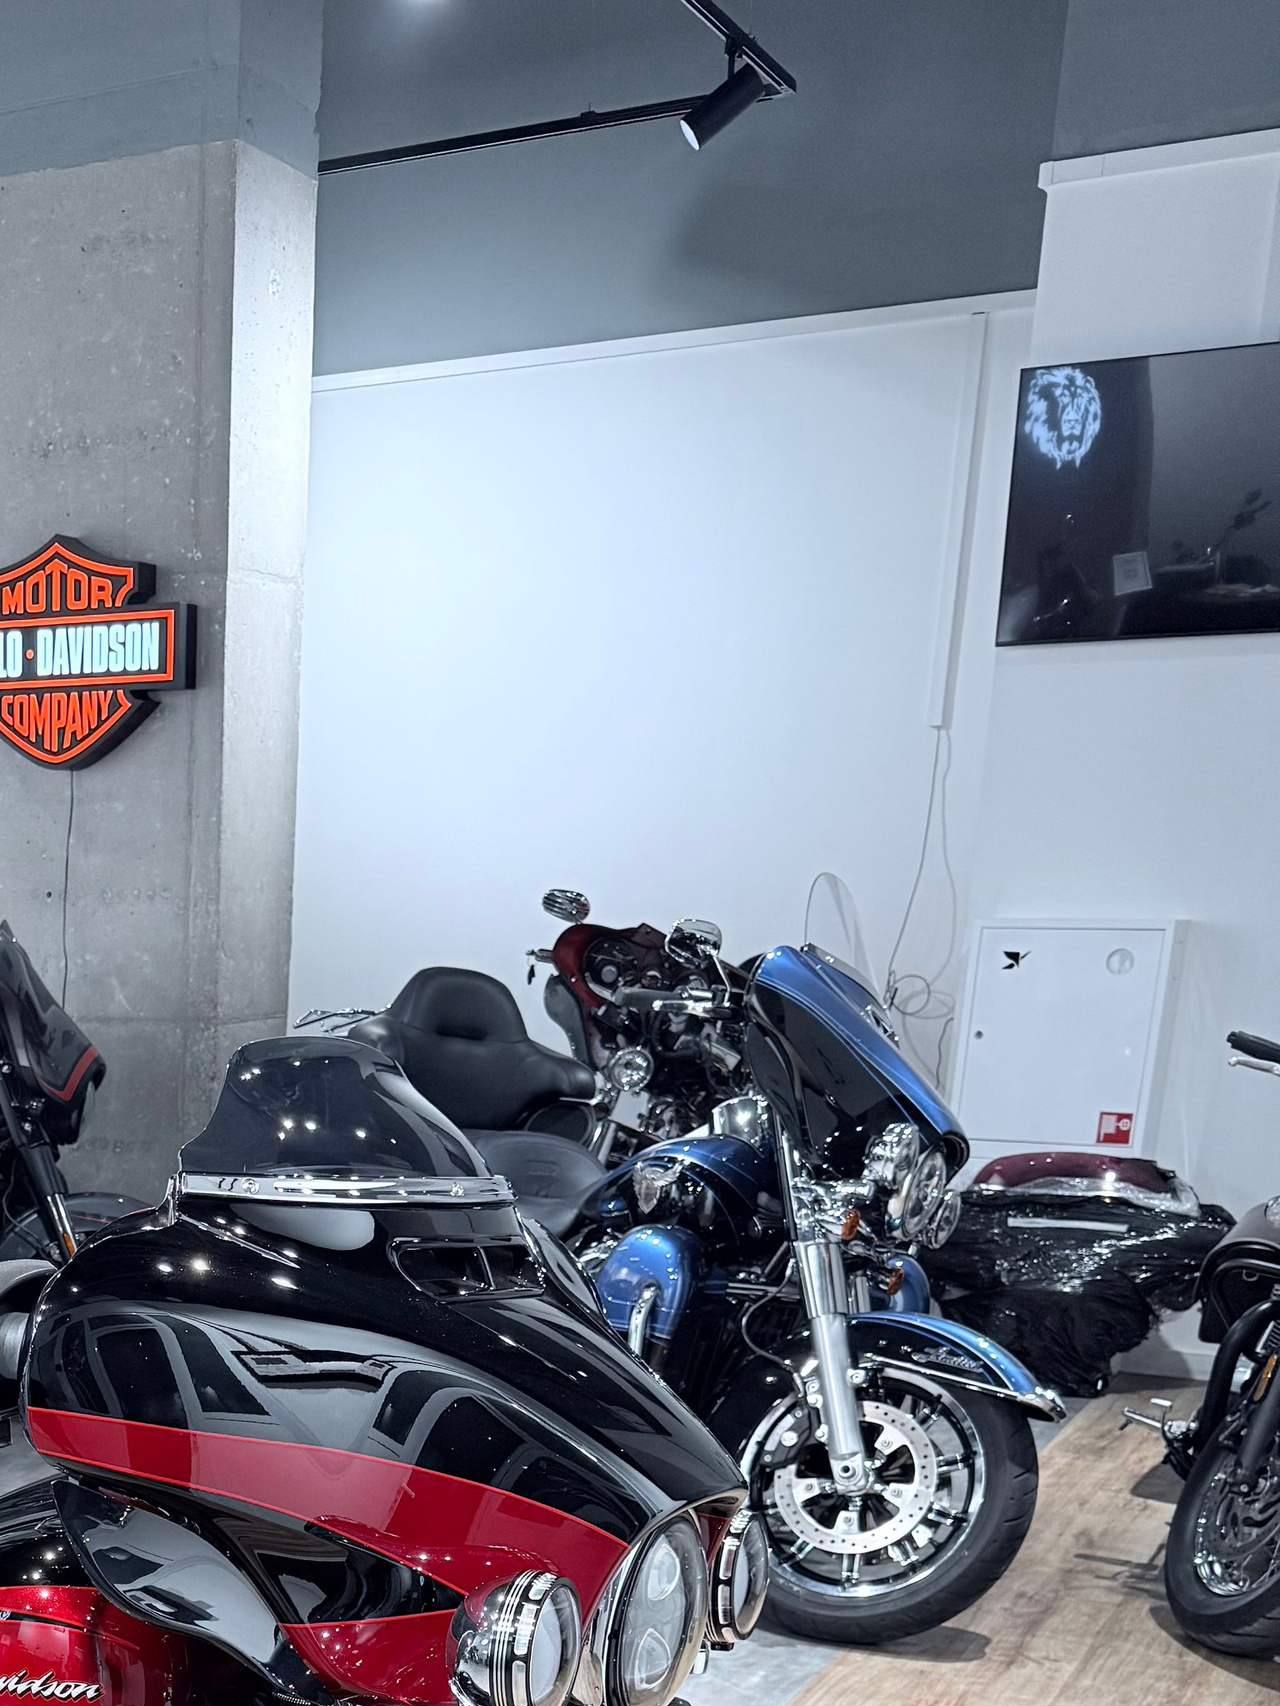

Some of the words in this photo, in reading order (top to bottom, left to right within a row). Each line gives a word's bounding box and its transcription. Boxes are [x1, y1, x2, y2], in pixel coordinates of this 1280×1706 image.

[1, 557, 114, 616] MOTOR
[36, 621, 160, 677] DAVIDSON
[0, 689, 114, 753] COMPANY
